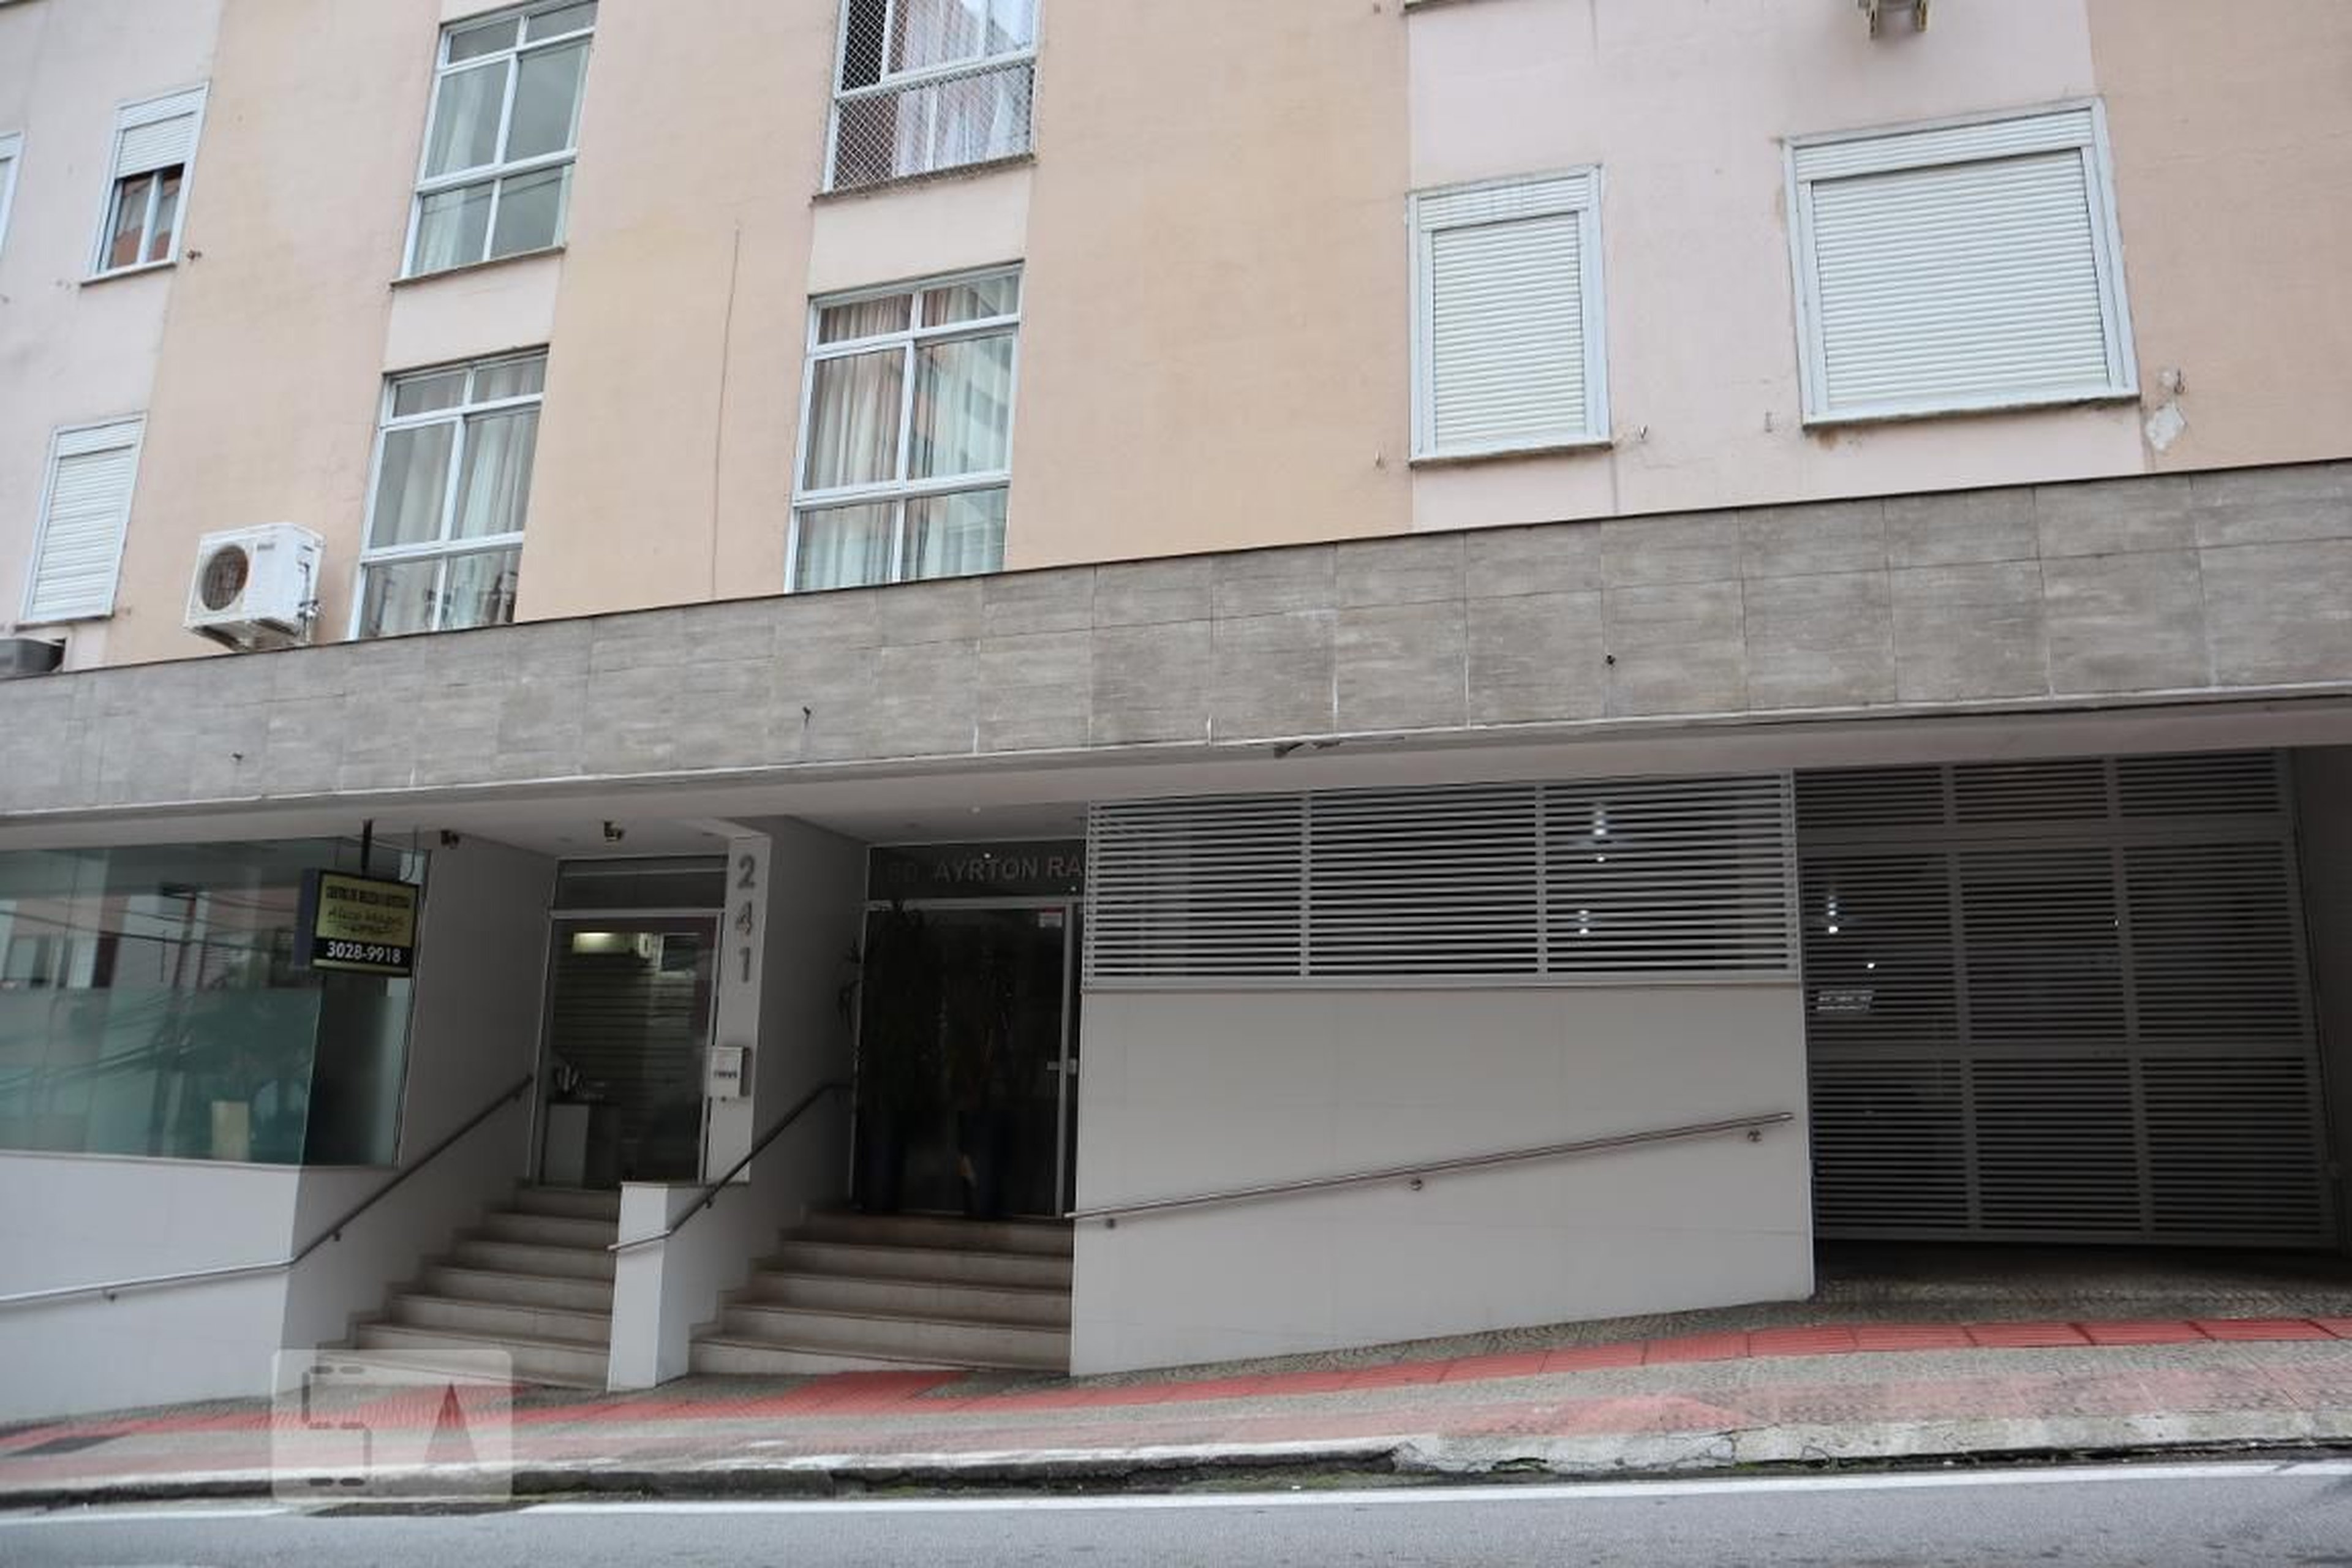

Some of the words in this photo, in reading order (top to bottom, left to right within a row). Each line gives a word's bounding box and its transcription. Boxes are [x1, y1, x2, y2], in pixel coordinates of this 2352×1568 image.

[934, 857, 1038, 882] AYRTON
[736, 854, 756, 984] 241
[326, 941, 401, 963] 3028-9918
